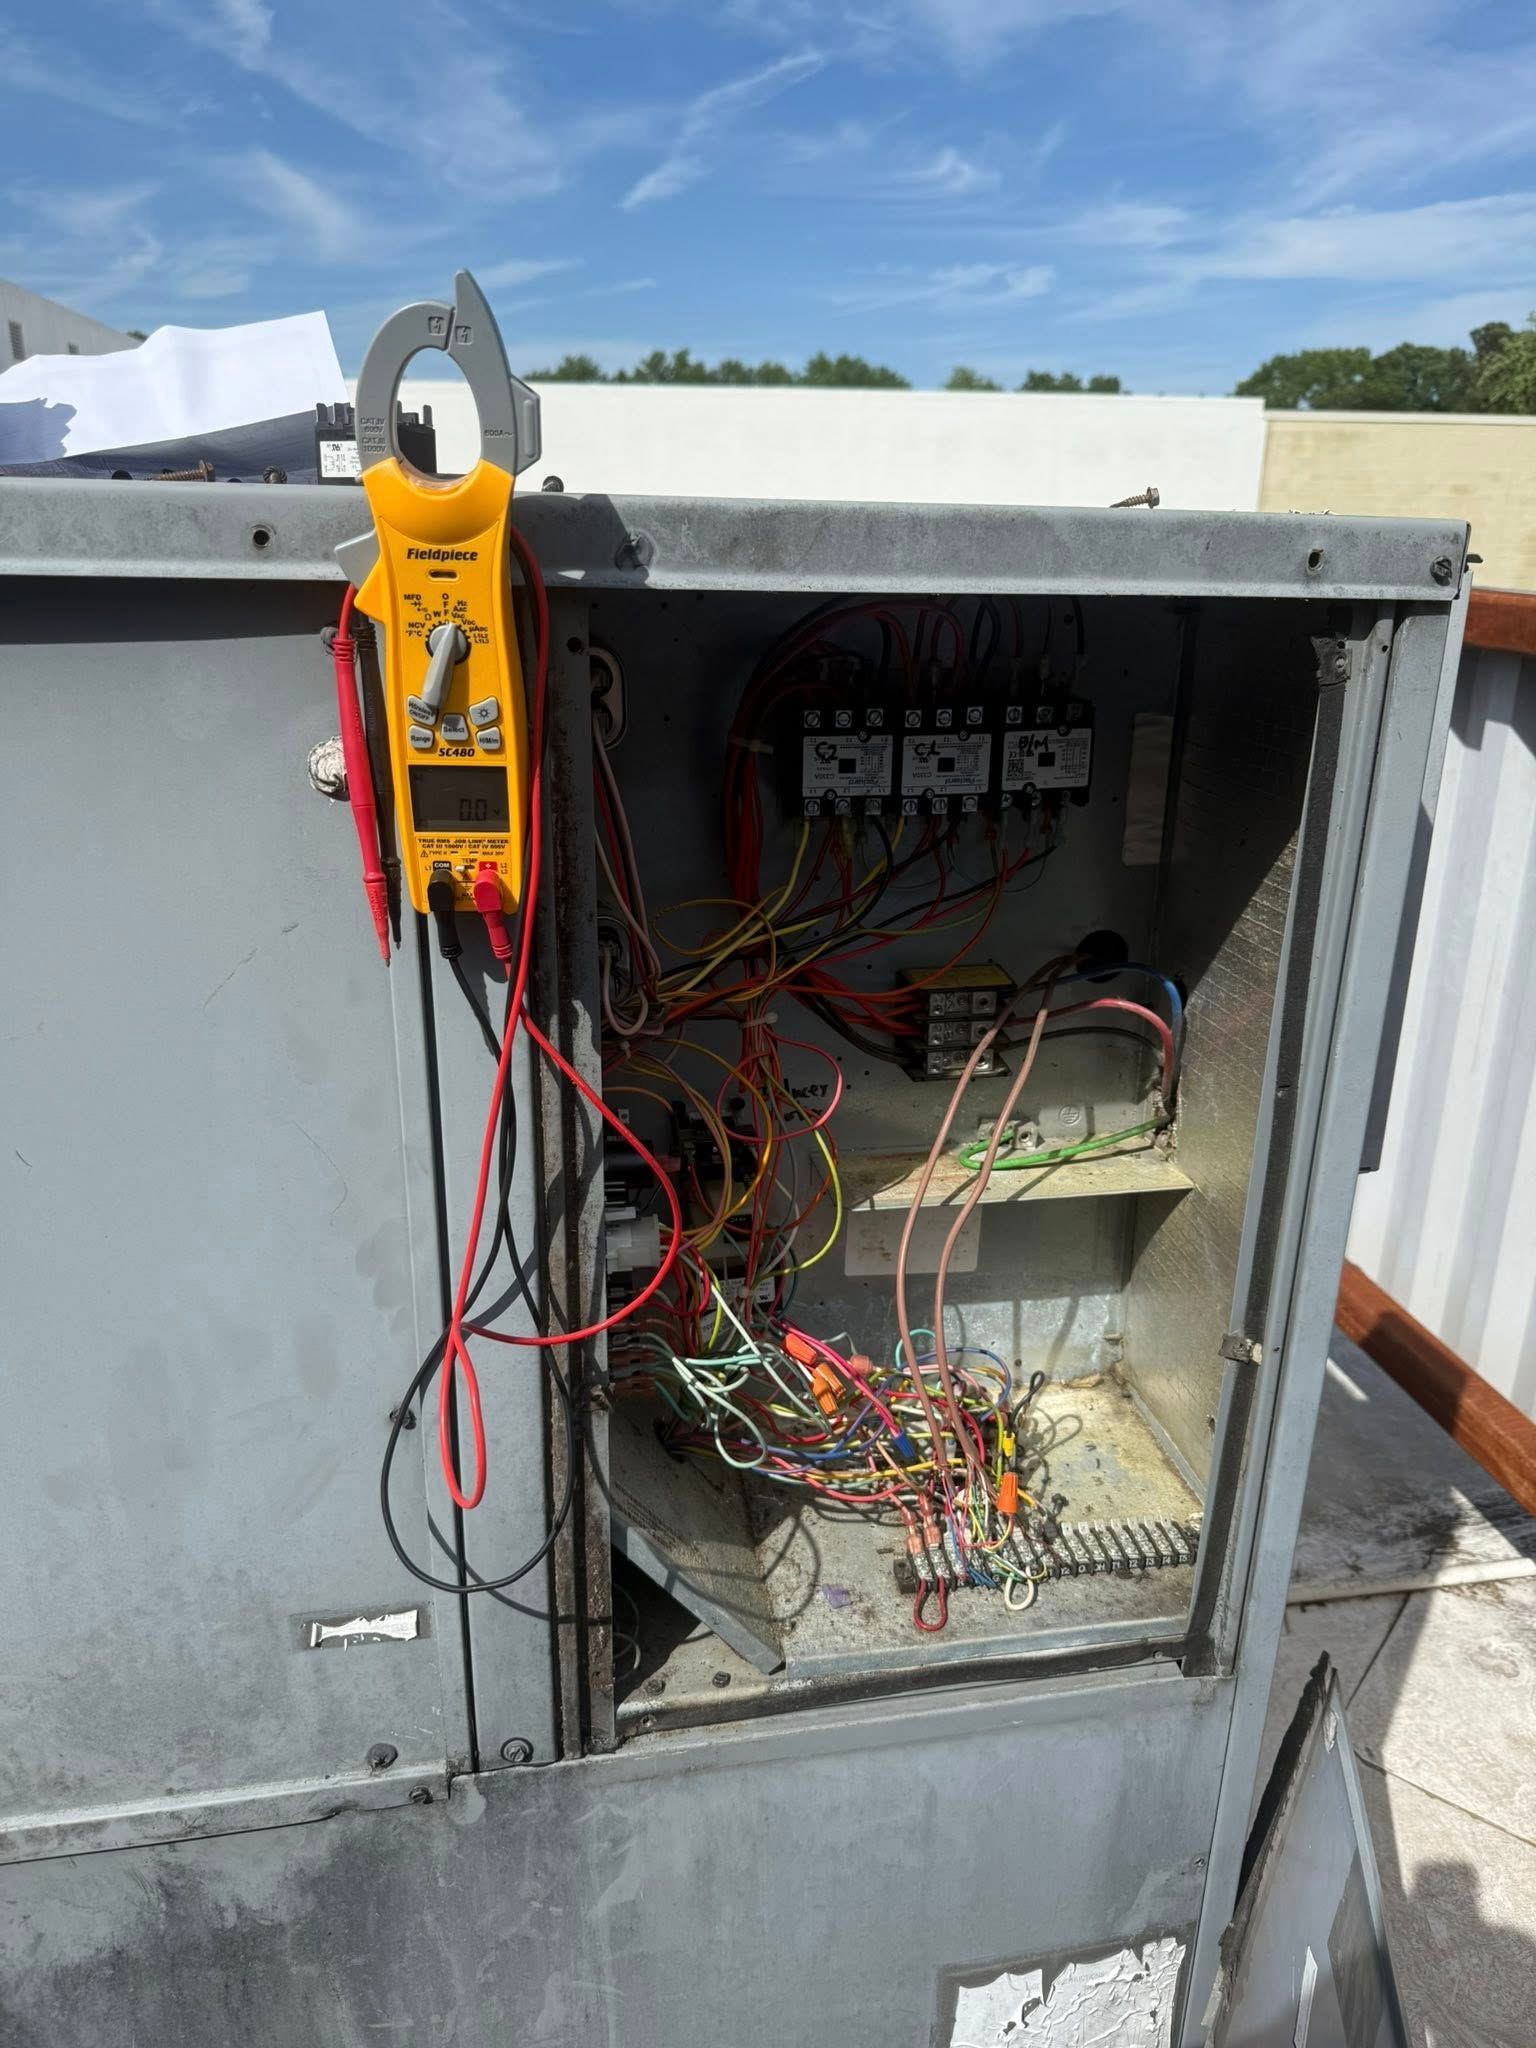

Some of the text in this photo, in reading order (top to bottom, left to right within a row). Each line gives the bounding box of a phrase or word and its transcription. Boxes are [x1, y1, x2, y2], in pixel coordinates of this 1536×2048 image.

[361, 417, 375, 425] CAT
[406, 548, 478, 562] Fieldpiece
[411, 735, 431, 743] Range
[438, 748, 475, 757] SC480
[815, 741, 838, 761] C2
[460, 799, 487, 821] 0.0
